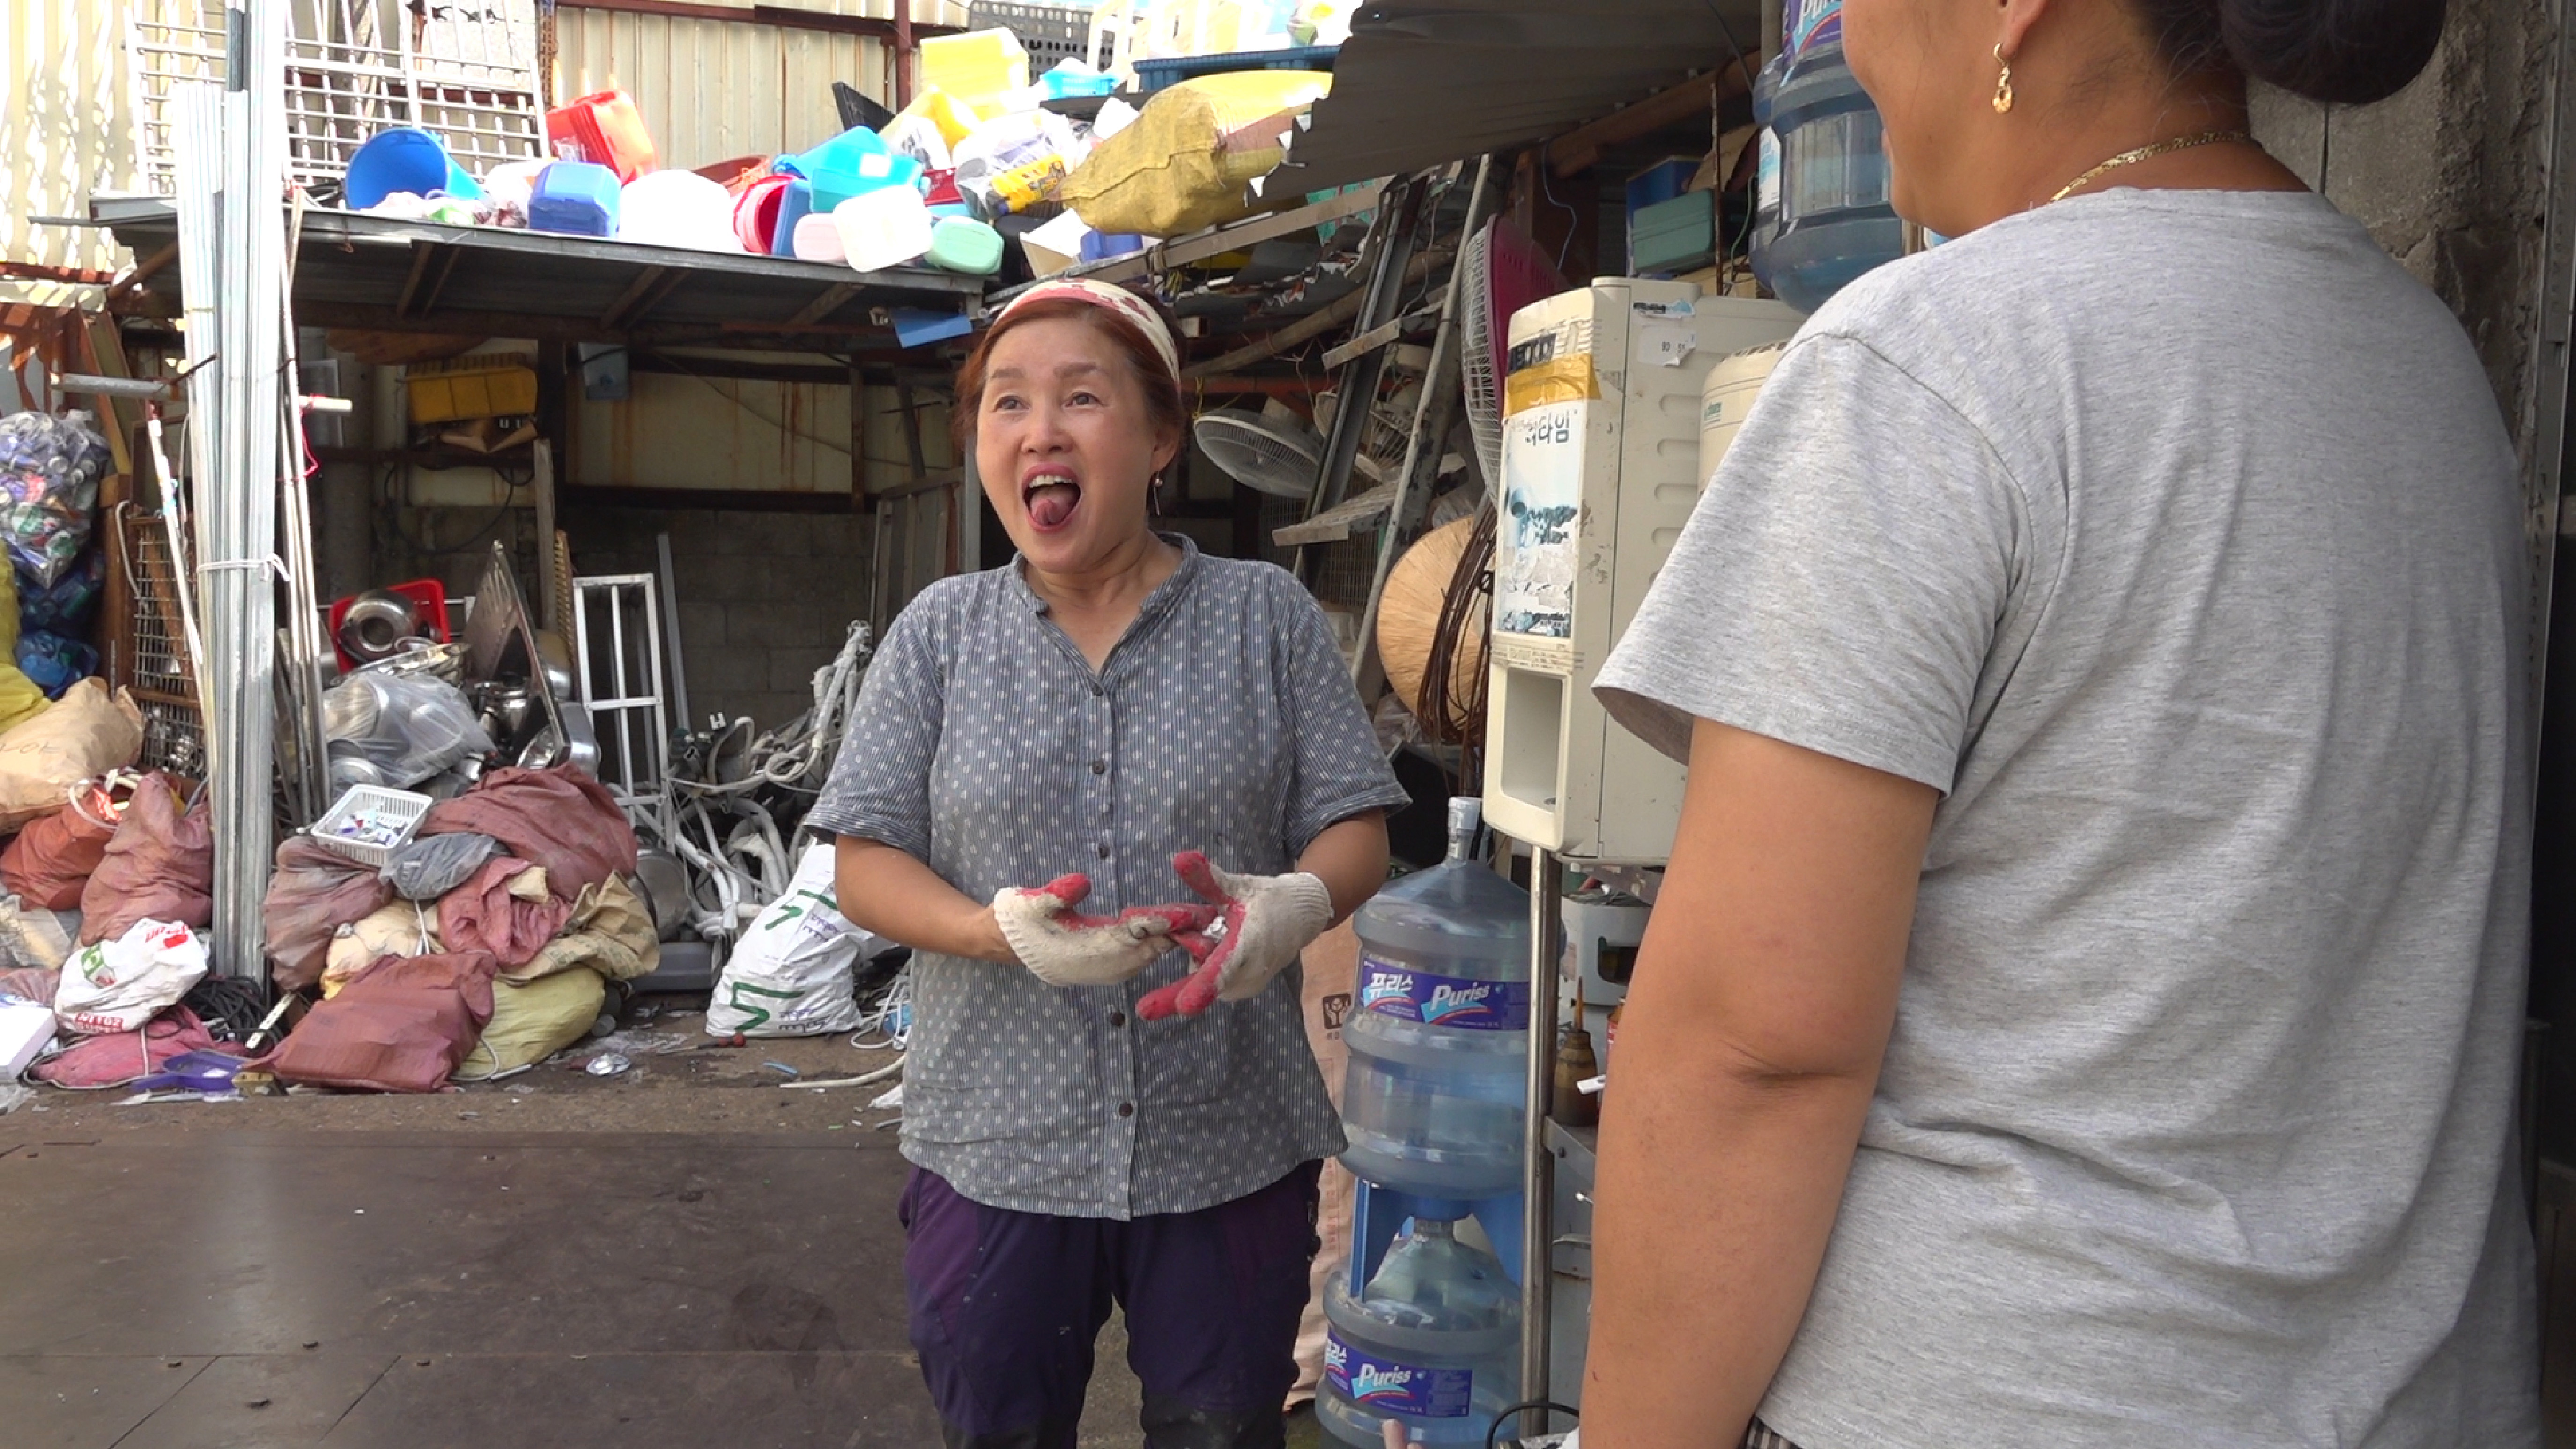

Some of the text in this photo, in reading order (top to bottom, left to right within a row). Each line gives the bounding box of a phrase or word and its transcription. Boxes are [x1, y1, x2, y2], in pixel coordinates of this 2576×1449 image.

[1369, 972, 1413, 998] 퓨리스
[1430, 982, 1490, 1012] Puriss
[1358, 1363, 1412, 1387] Puriss
